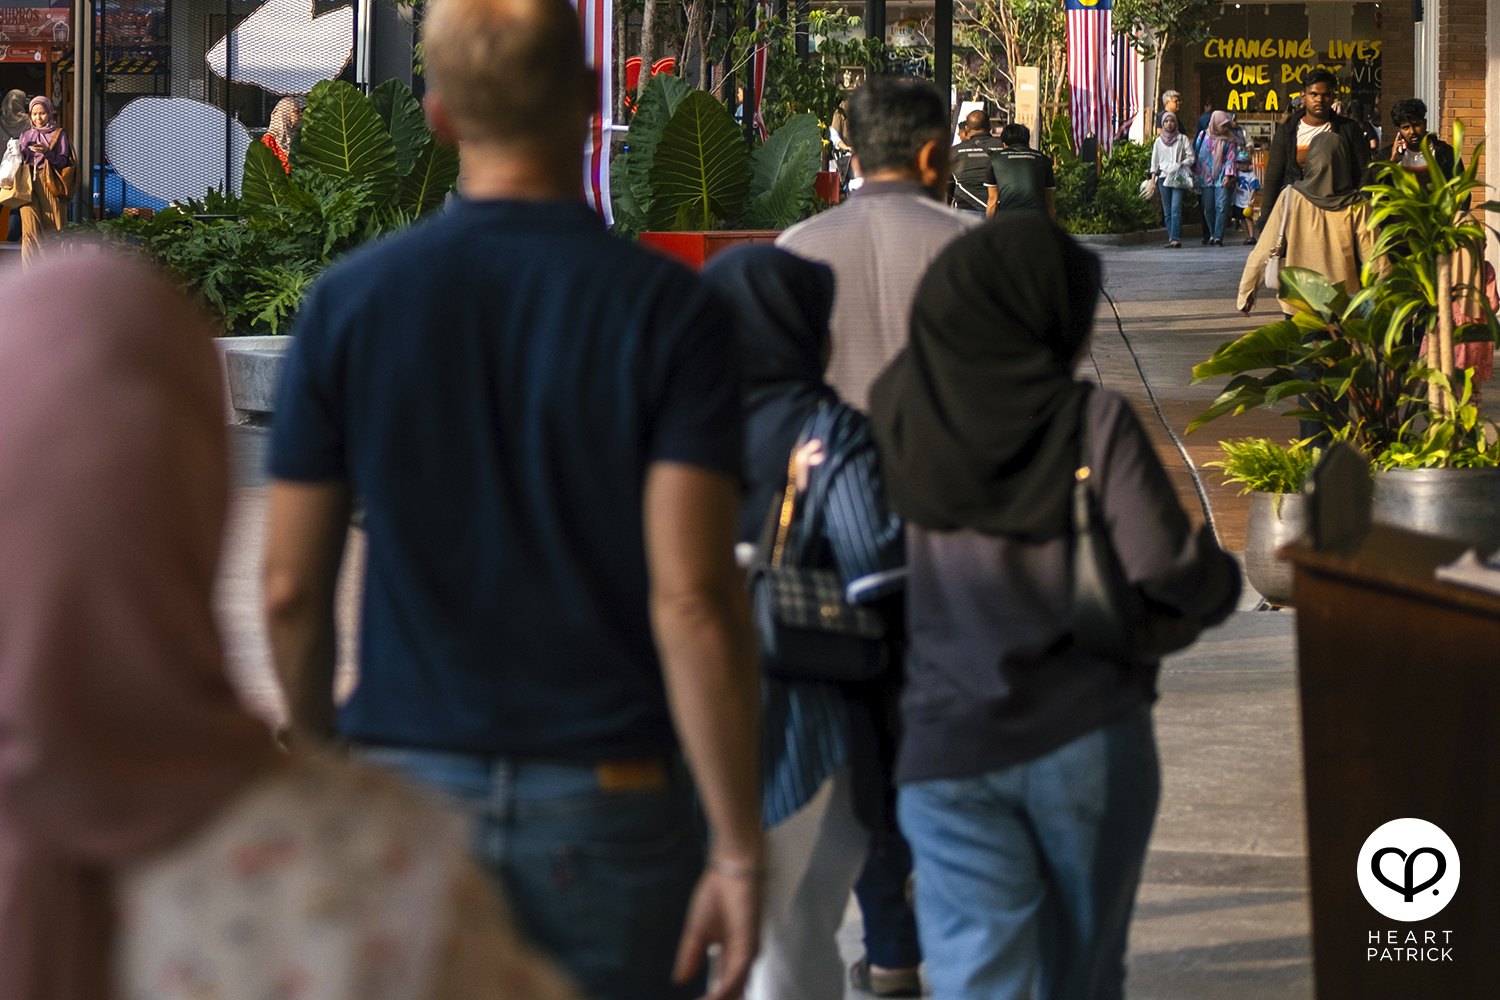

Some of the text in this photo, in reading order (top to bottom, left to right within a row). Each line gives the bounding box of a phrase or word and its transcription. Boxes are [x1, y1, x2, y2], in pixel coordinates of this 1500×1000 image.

[1204, 38, 1382, 60] CHANGING LIVES
[1226, 63, 1271, 85] ONE
[1227, 89, 1256, 111] AT
[1265, 89, 1279, 111] A
